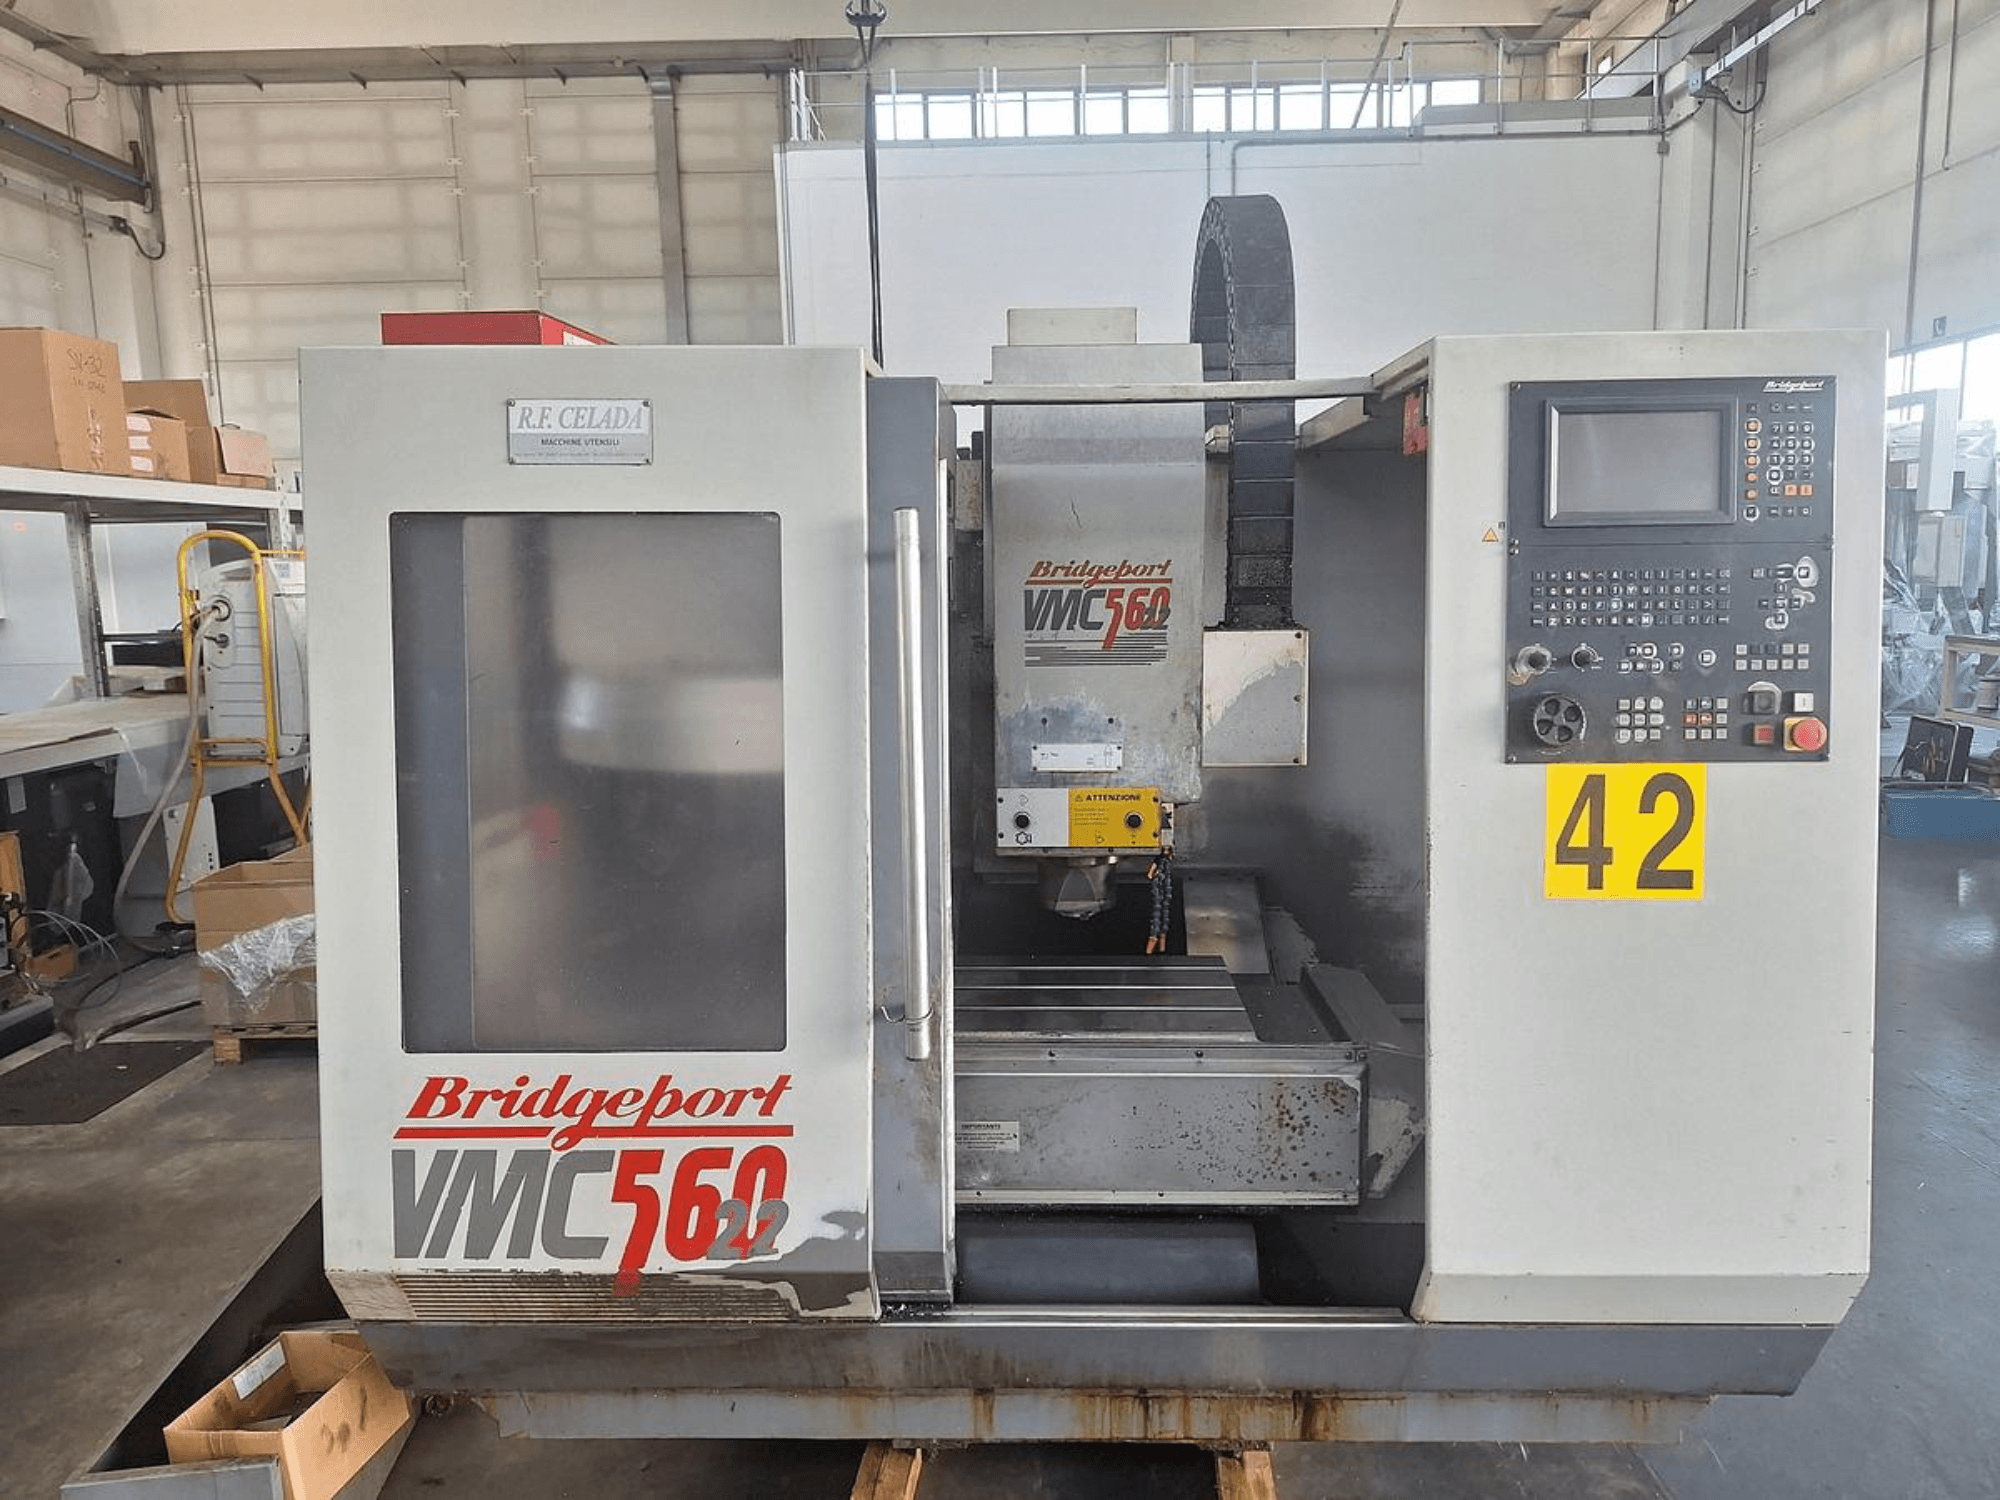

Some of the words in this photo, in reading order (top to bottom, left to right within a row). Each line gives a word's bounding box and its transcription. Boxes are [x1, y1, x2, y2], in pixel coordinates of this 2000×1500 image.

[1763, 381, 1824, 393] Bridgeport
[517, 406, 552, 429] R.F.
[558, 406, 643, 430] CELADA
[541, 438, 581, 446] MACCHINE
[584, 438, 620, 446] UTENSILI
[1029, 559, 1172, 589] Bridgeport
[1555, 772, 1695, 890] 42
[405, 1074, 792, 1151] Bridgeport
